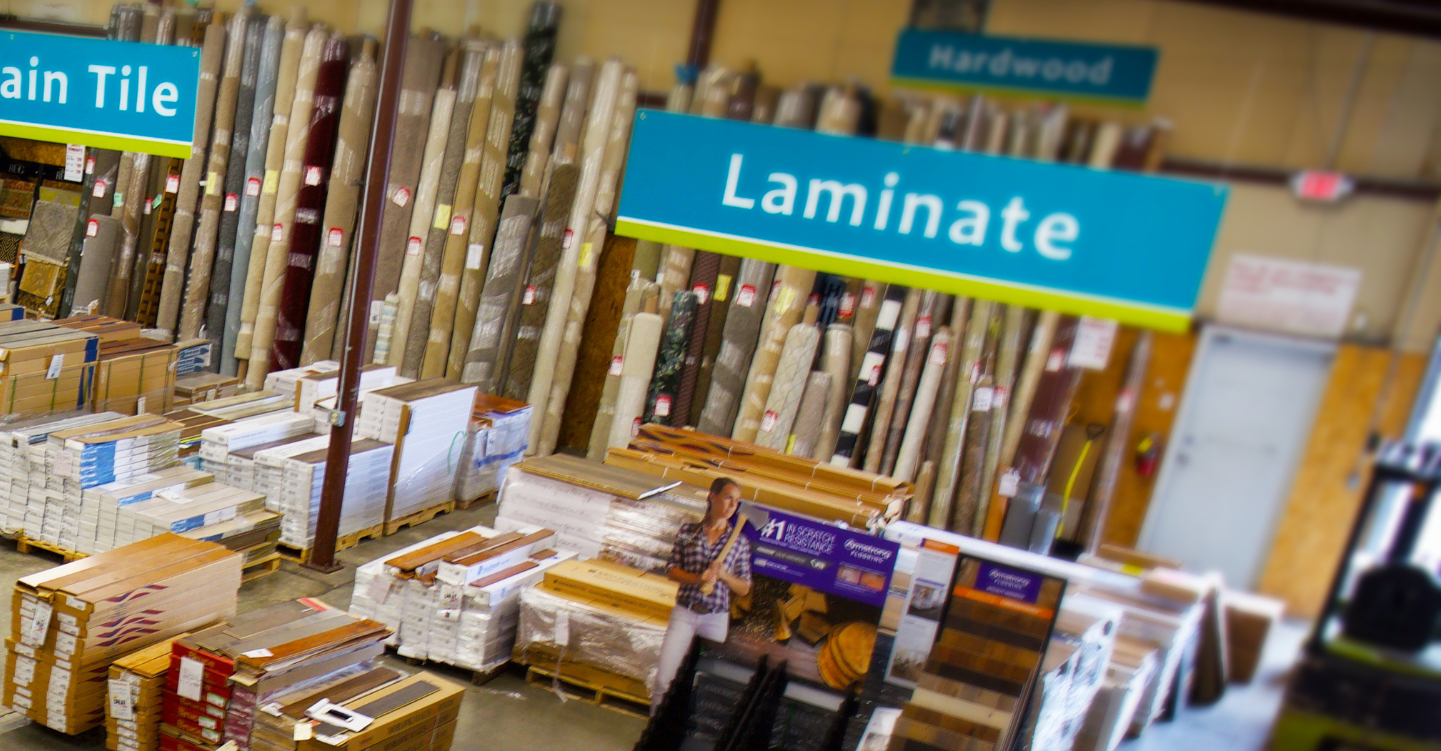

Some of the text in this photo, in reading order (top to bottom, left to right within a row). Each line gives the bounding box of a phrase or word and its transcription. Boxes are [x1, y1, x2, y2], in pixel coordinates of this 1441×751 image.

[928, 44, 1114, 86] Hardwood
[88, 64, 179, 117] Tile
[721, 152, 1080, 261] Laminate
[760, 517, 837, 544] #1 IN SCRATCH
[783, 533, 836, 555] RESISTANCE
[844, 538, 893, 559] Armstrong
[850, 550, 884, 564] FLOORING
[989, 568, 1032, 586] Armstrong
